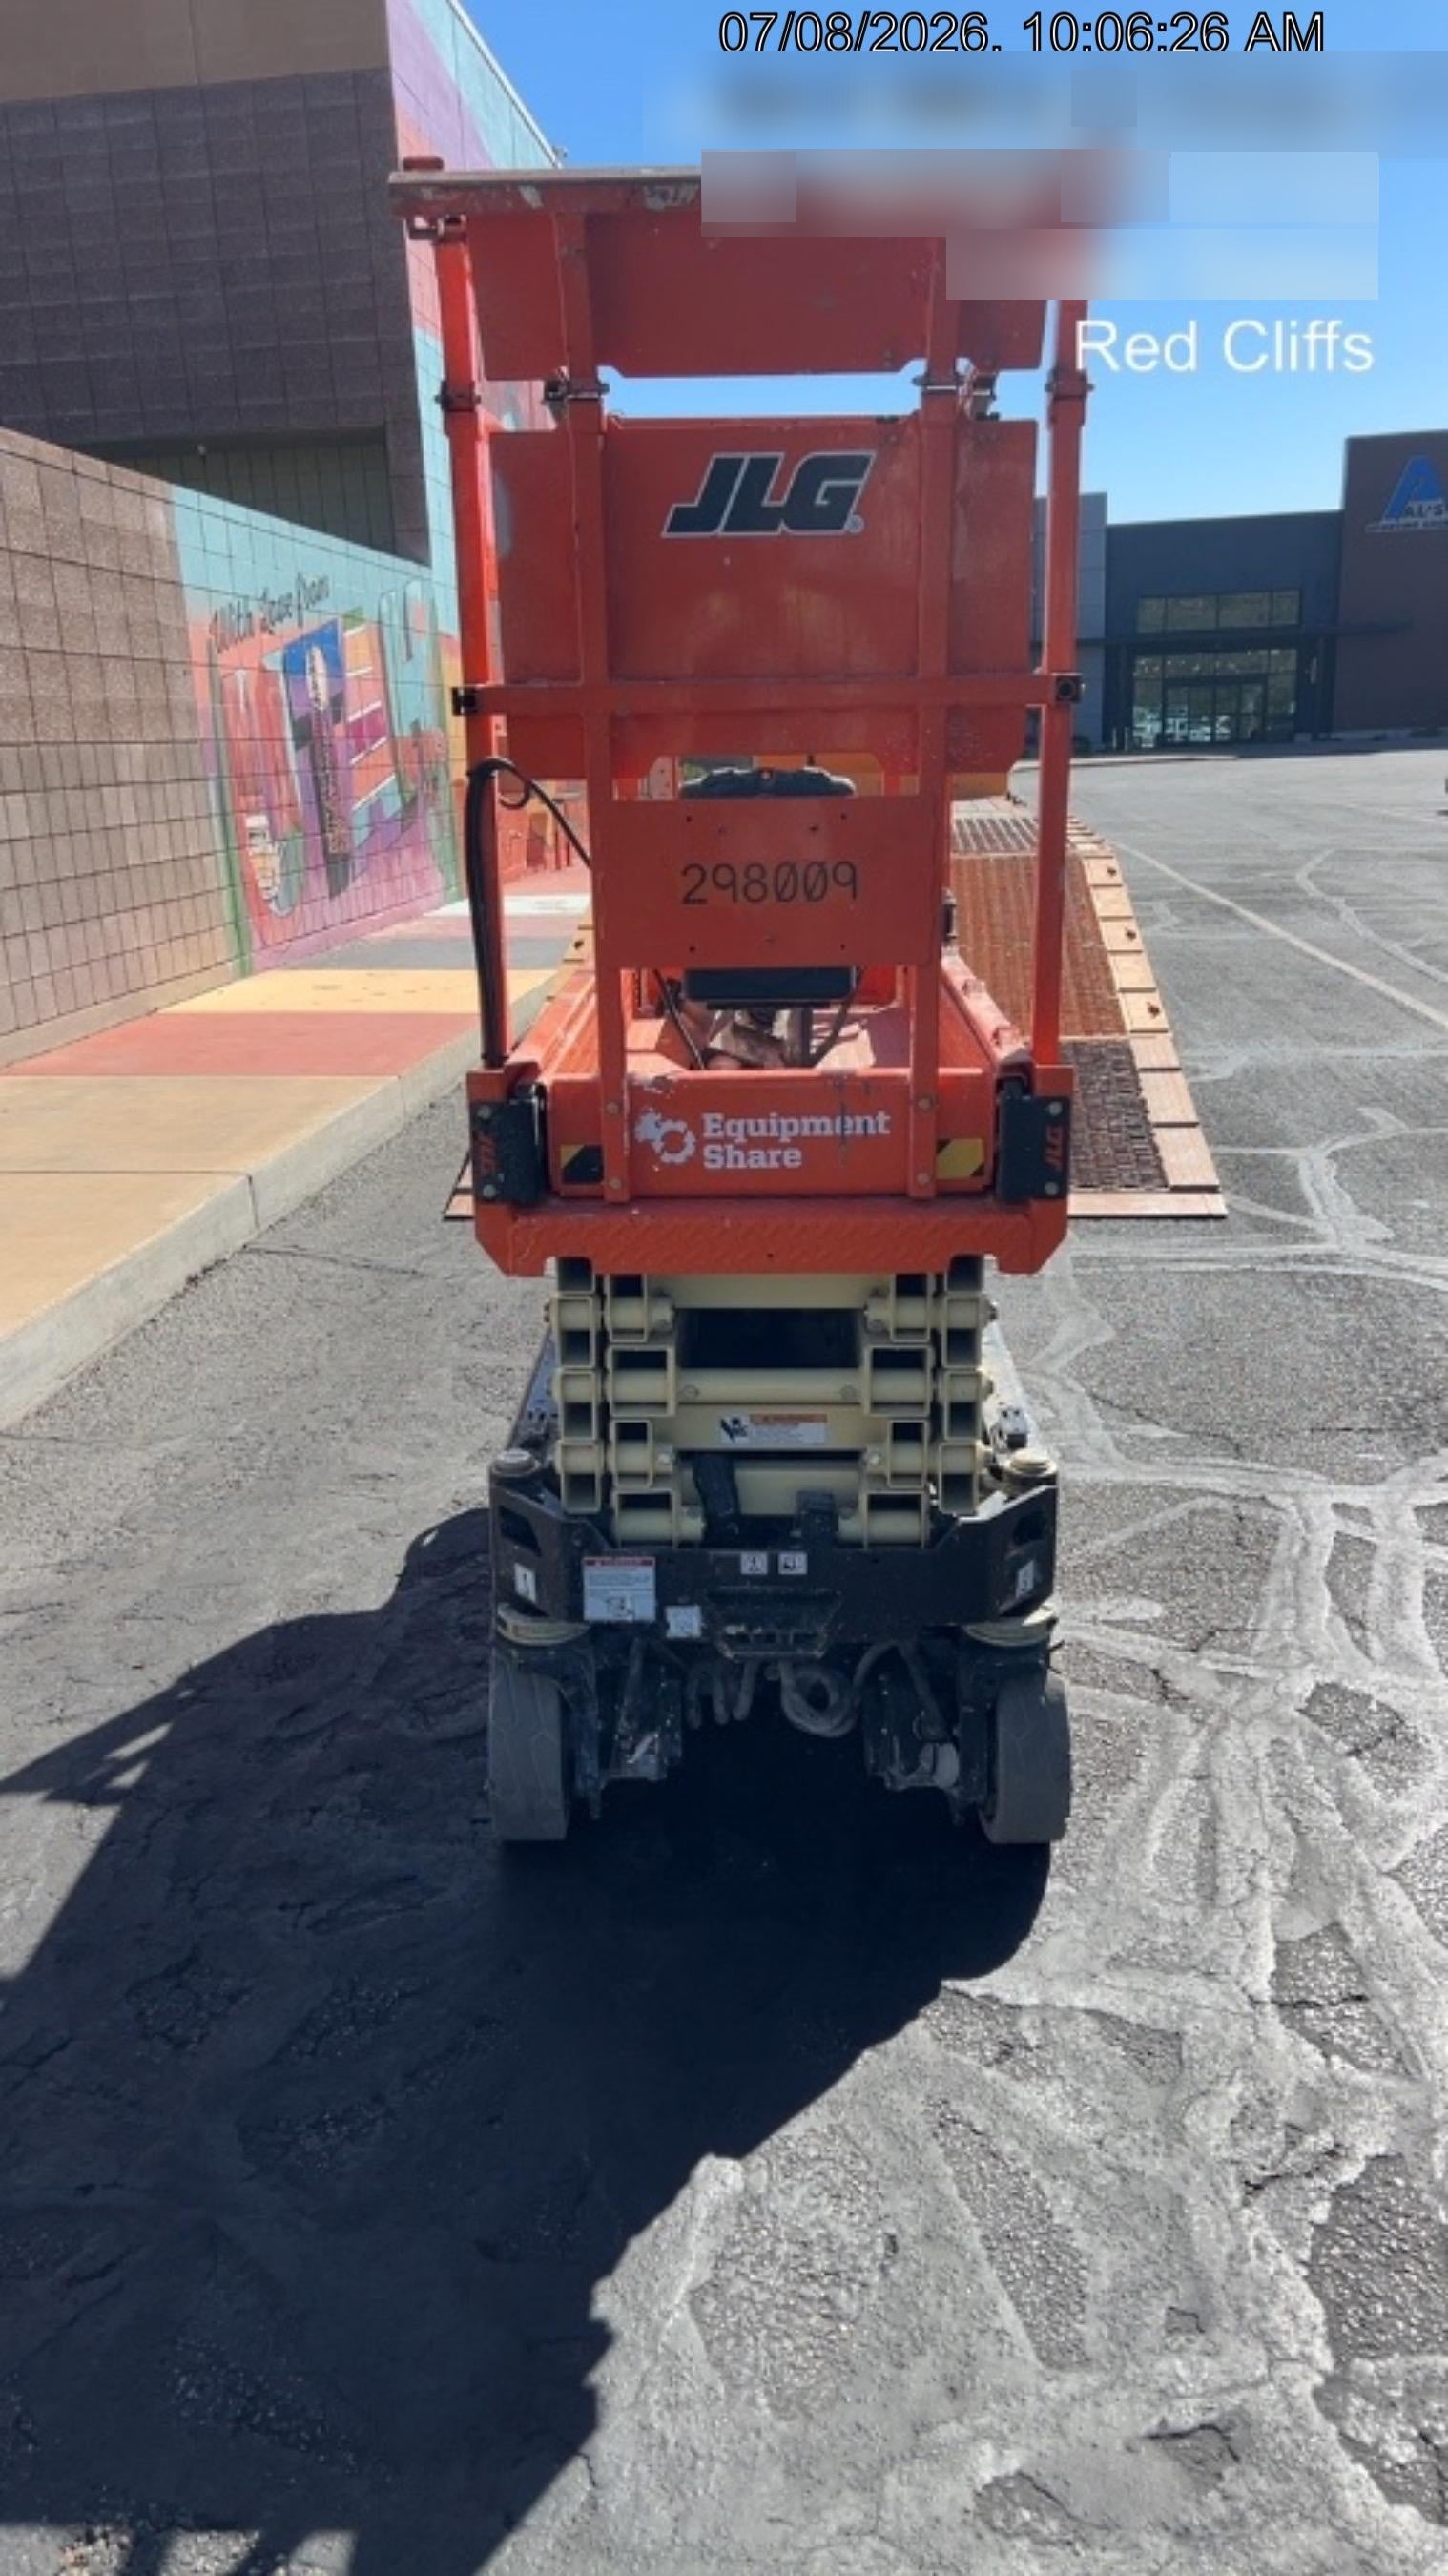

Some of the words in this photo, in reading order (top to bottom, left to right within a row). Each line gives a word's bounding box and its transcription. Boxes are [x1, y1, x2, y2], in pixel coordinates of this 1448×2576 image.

[661, 448, 877, 539] JLG
[681, 860, 857, 905] 298009
[701, 1110, 892, 1143] Equipment
[702, 1143, 803, 1170] Share
